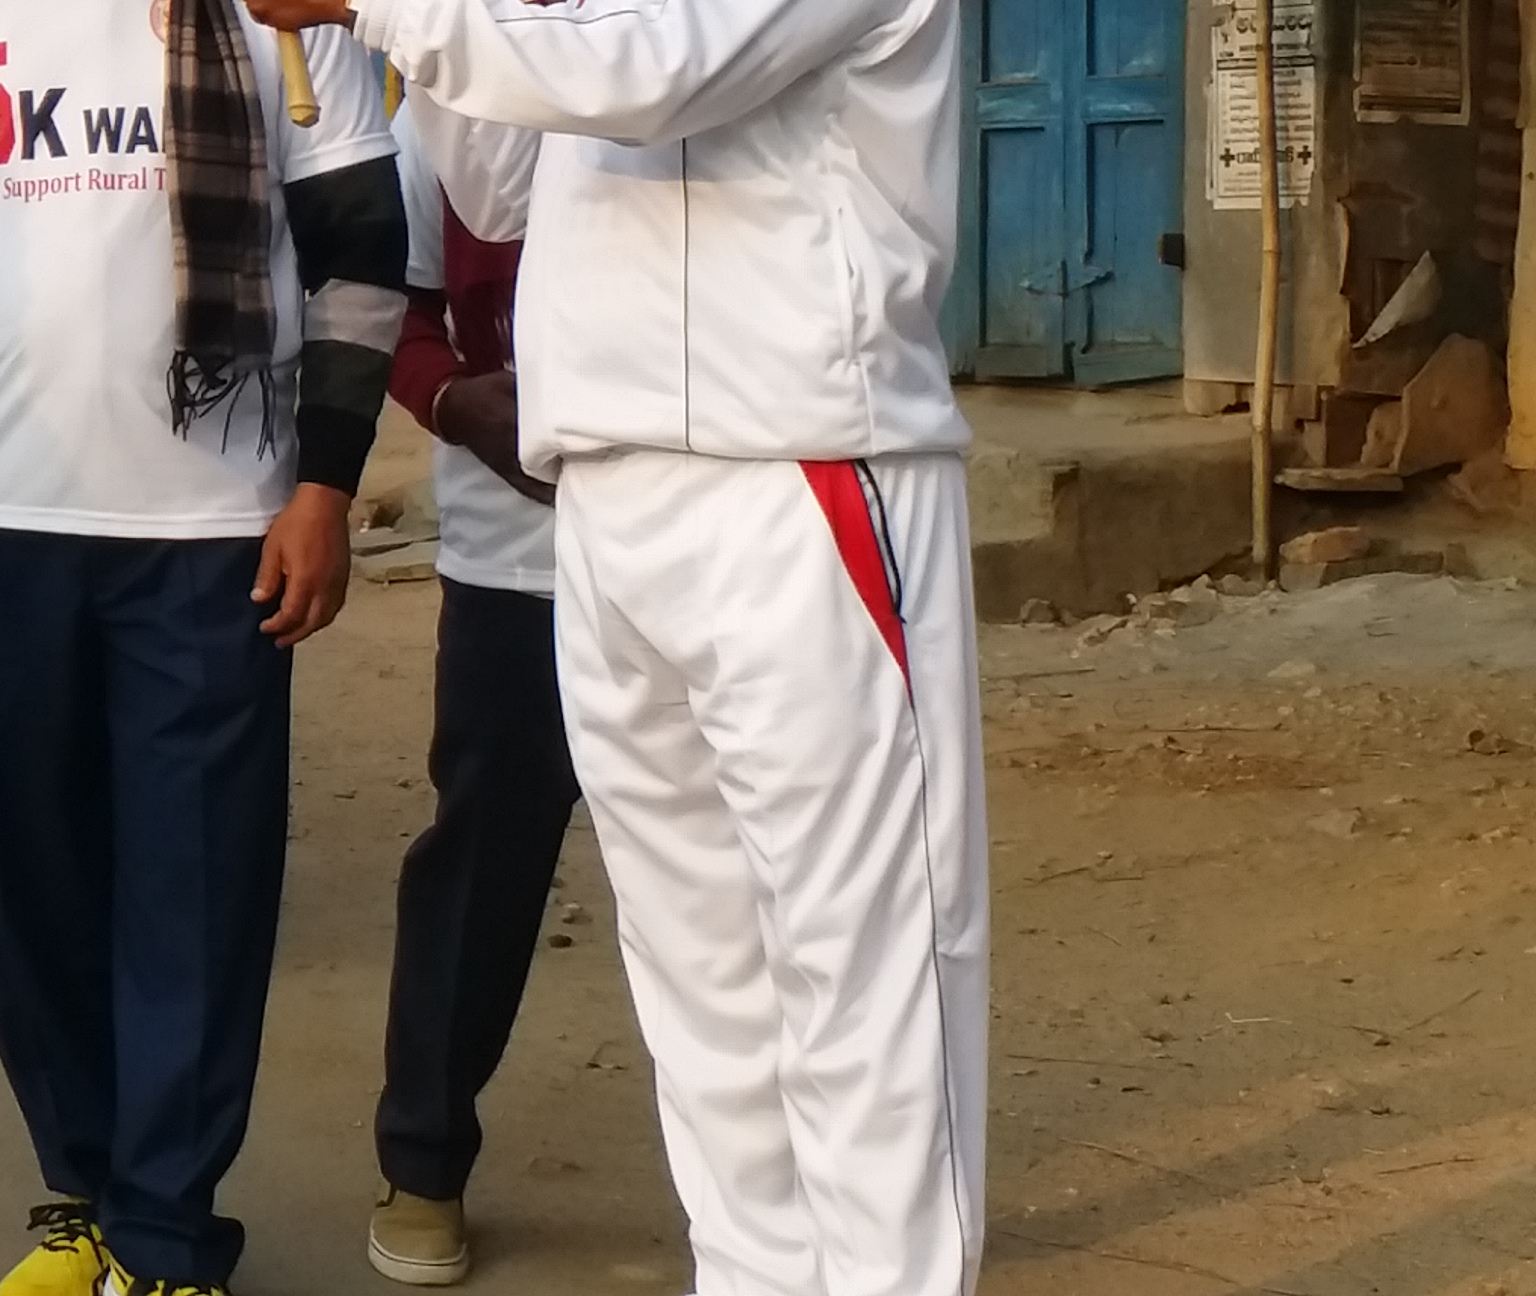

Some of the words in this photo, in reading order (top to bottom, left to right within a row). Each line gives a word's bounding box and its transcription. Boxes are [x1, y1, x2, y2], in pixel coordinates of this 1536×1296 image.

[83, 106, 167, 155] WA
[3, 172, 81, 203] Support
[88, 167, 147, 191] Rural
